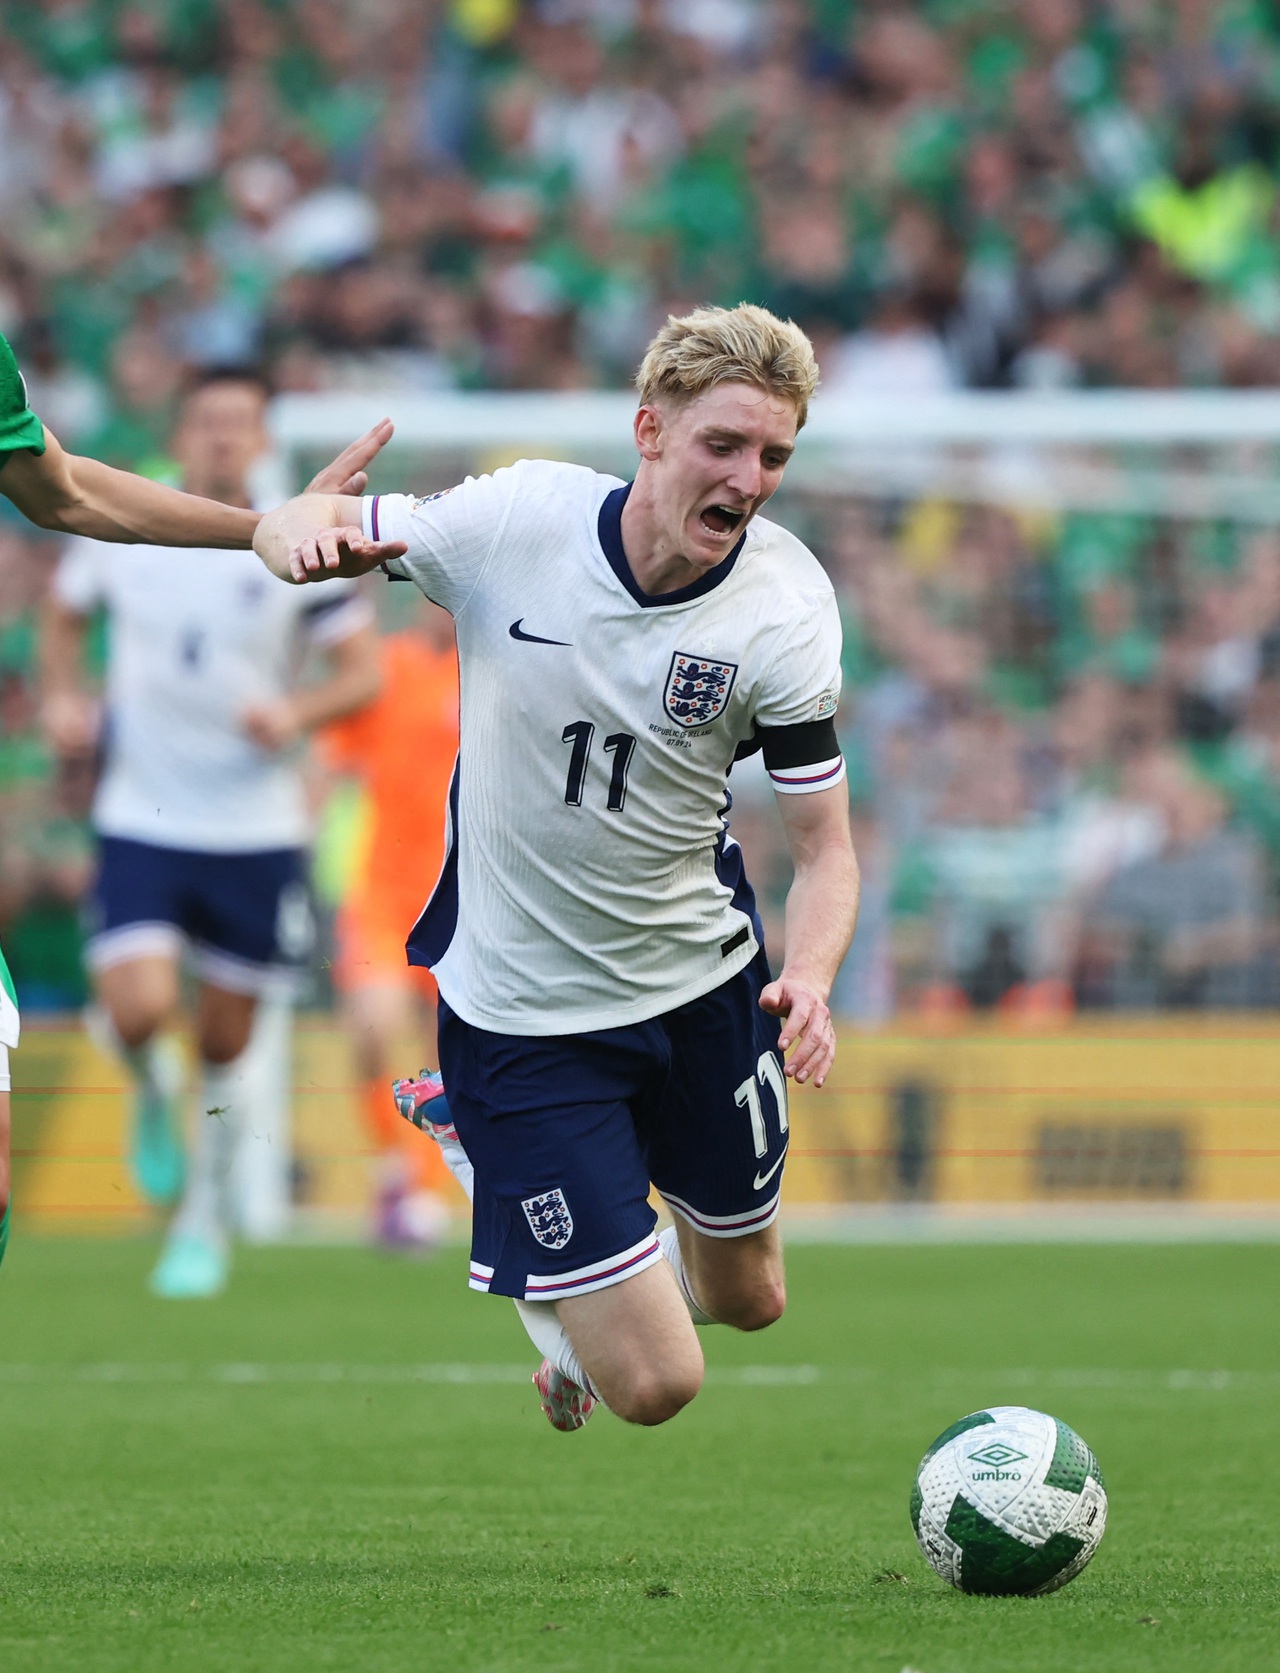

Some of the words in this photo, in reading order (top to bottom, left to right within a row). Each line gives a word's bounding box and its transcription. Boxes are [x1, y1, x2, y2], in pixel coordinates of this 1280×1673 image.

[648, 723, 680, 737] REPUBLIC
[687, 729, 713, 738] IRELAND
[562, 720, 637, 812] 11
[734, 1050, 789, 1159] 11
[972, 1469, 1022, 1482] umbro
